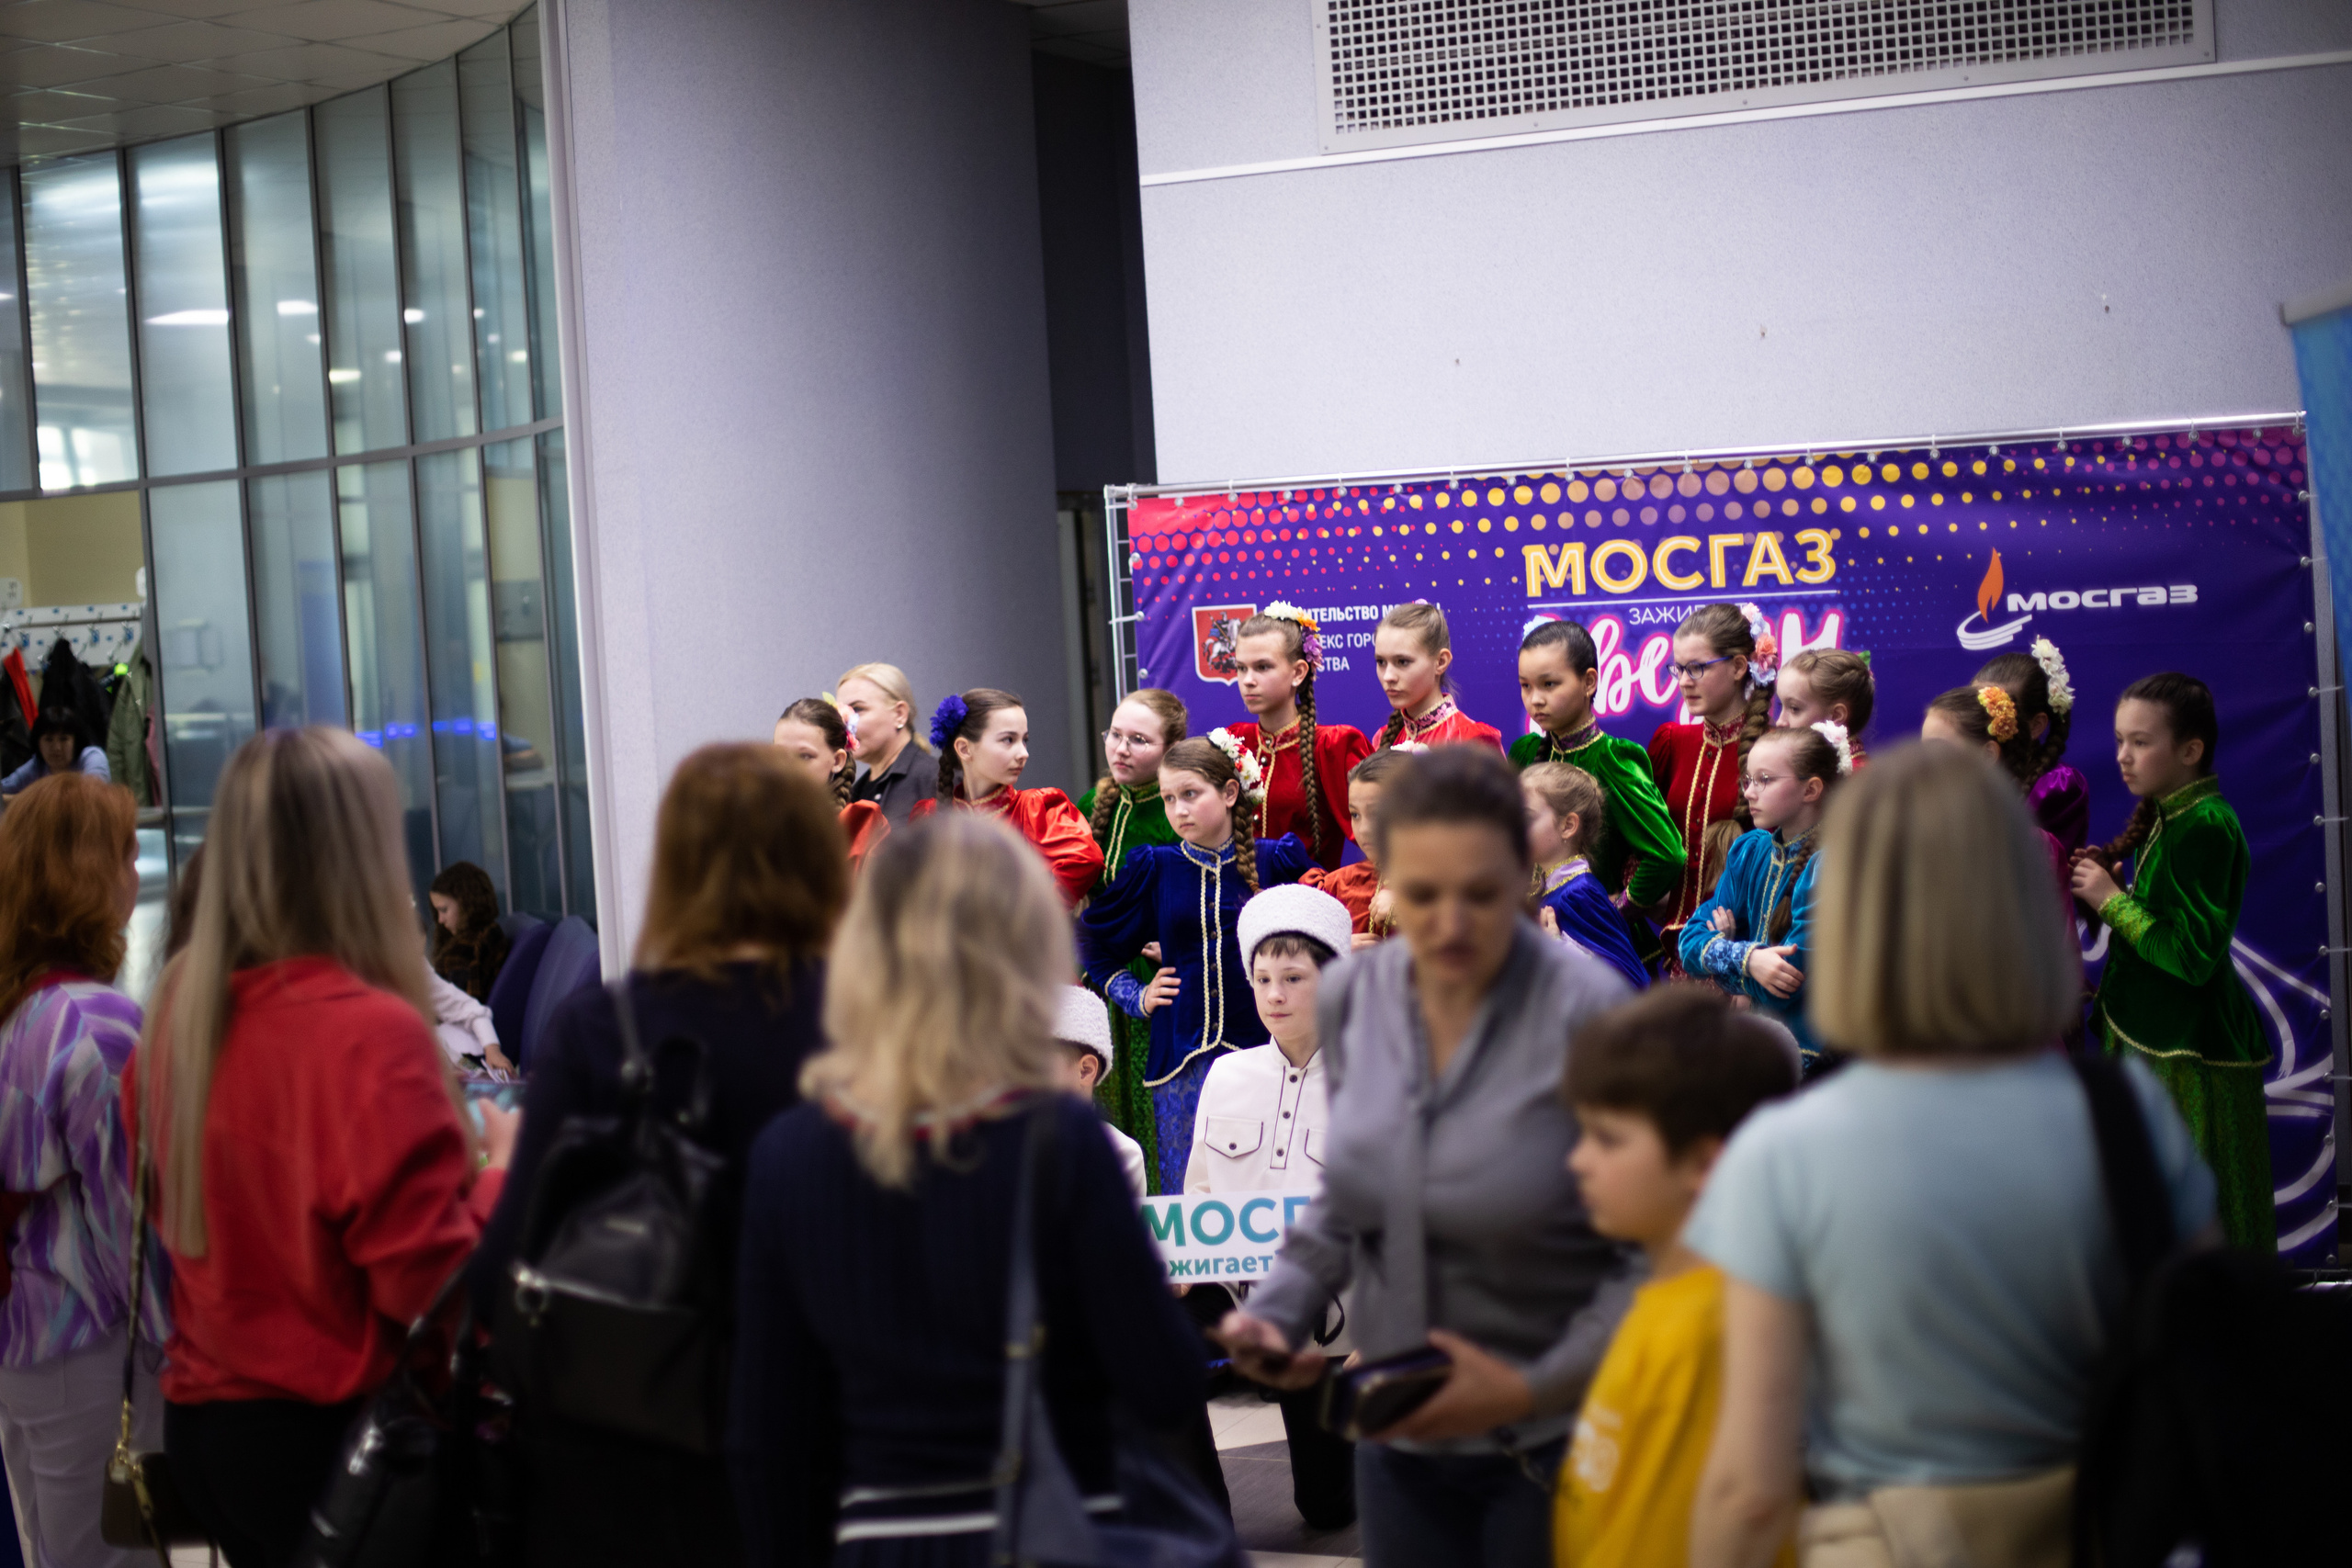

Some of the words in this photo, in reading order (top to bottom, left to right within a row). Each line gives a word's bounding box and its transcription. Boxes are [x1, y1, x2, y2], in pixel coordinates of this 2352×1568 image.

[1524, 528, 1837, 597] МОСГАЗ
[1303, 605, 1379, 623] ИТЕЛЬСТВО
[1319, 634, 1344, 649] ЕКС
[1347, 632, 1376, 649] ГОР
[1317, 656, 1351, 672] СТВА
[1142, 1196, 1311, 1247] МОСГ
[1169, 1255, 1273, 1277] жигает
